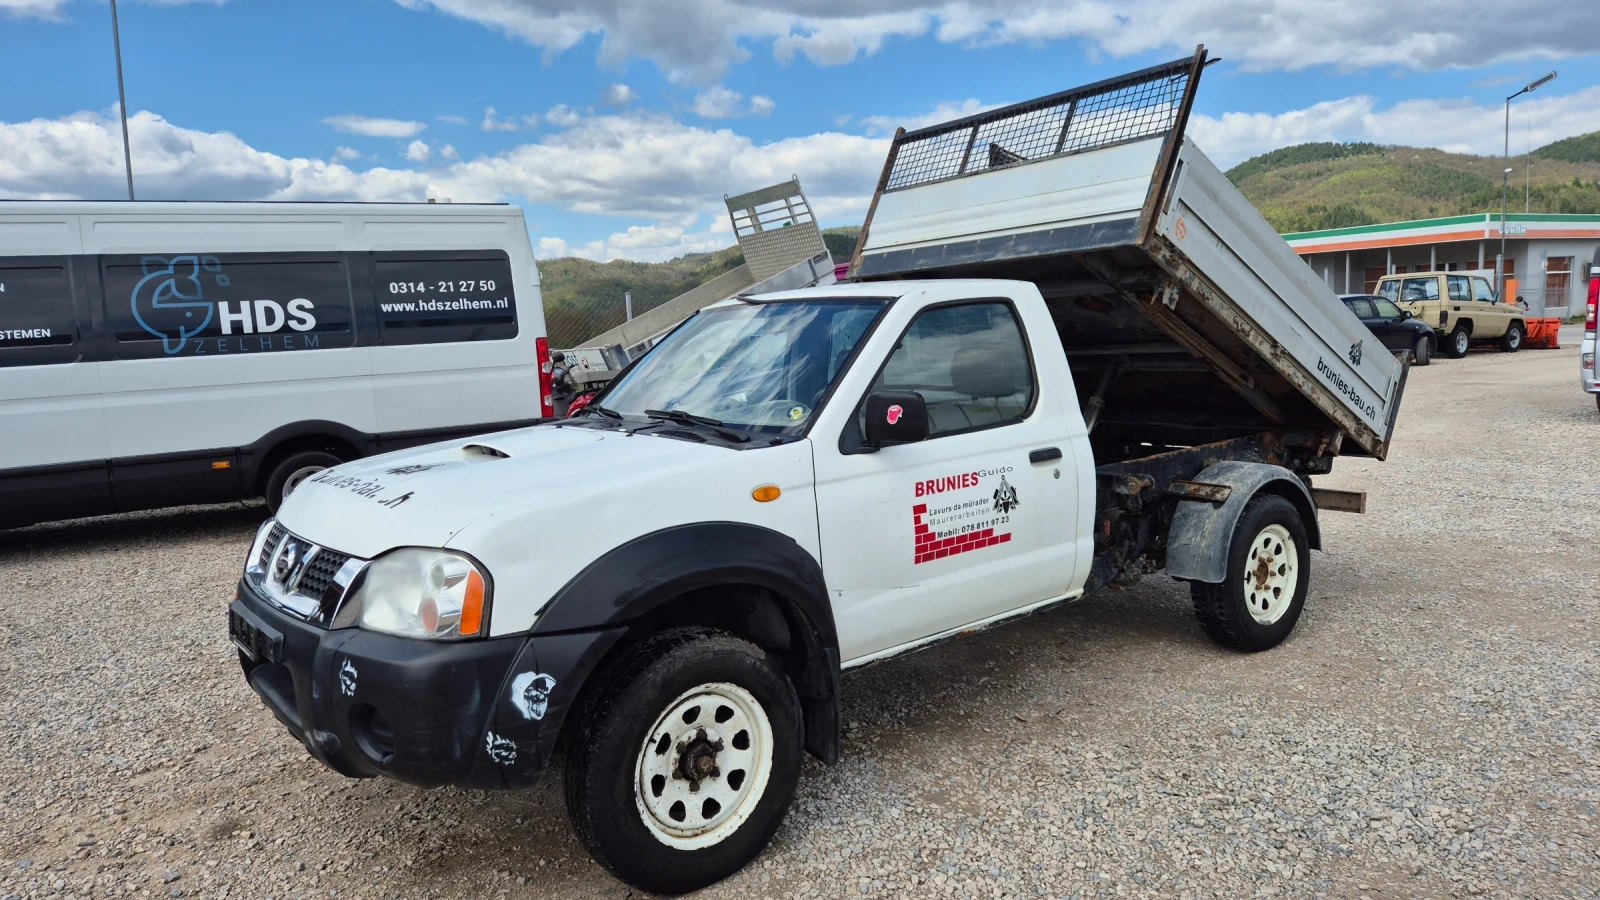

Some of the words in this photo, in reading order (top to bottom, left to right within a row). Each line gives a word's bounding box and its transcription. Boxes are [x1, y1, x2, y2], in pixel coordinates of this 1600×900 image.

[389, 282, 425, 293] 0314
[438, 281, 454, 292] 21
[458, 280, 475, 292] 27
[479, 280, 496, 291] 50
[380, 297, 509, 312] www.hdszelhem.nl
[218, 298, 316, 334] HDS
[194, 334, 319, 353] ZELHEM
[1317, 356, 1376, 421] brunies-bau.ch
[915, 471, 979, 498] BRUNIES
[978, 466, 1013, 478] Guido
[929, 505, 952, 516] Lavurs
[953, 503, 961, 511] da
[962, 498, 989, 509] mürader
[929, 507, 990, 526] Maurerarbeiten
[937, 528, 960, 539] Mobil:
[961, 523, 975, 533] 078
[976, 521, 989, 530] 811
[990, 517, 999, 527] 97
[1000, 515, 1010, 524] 23
